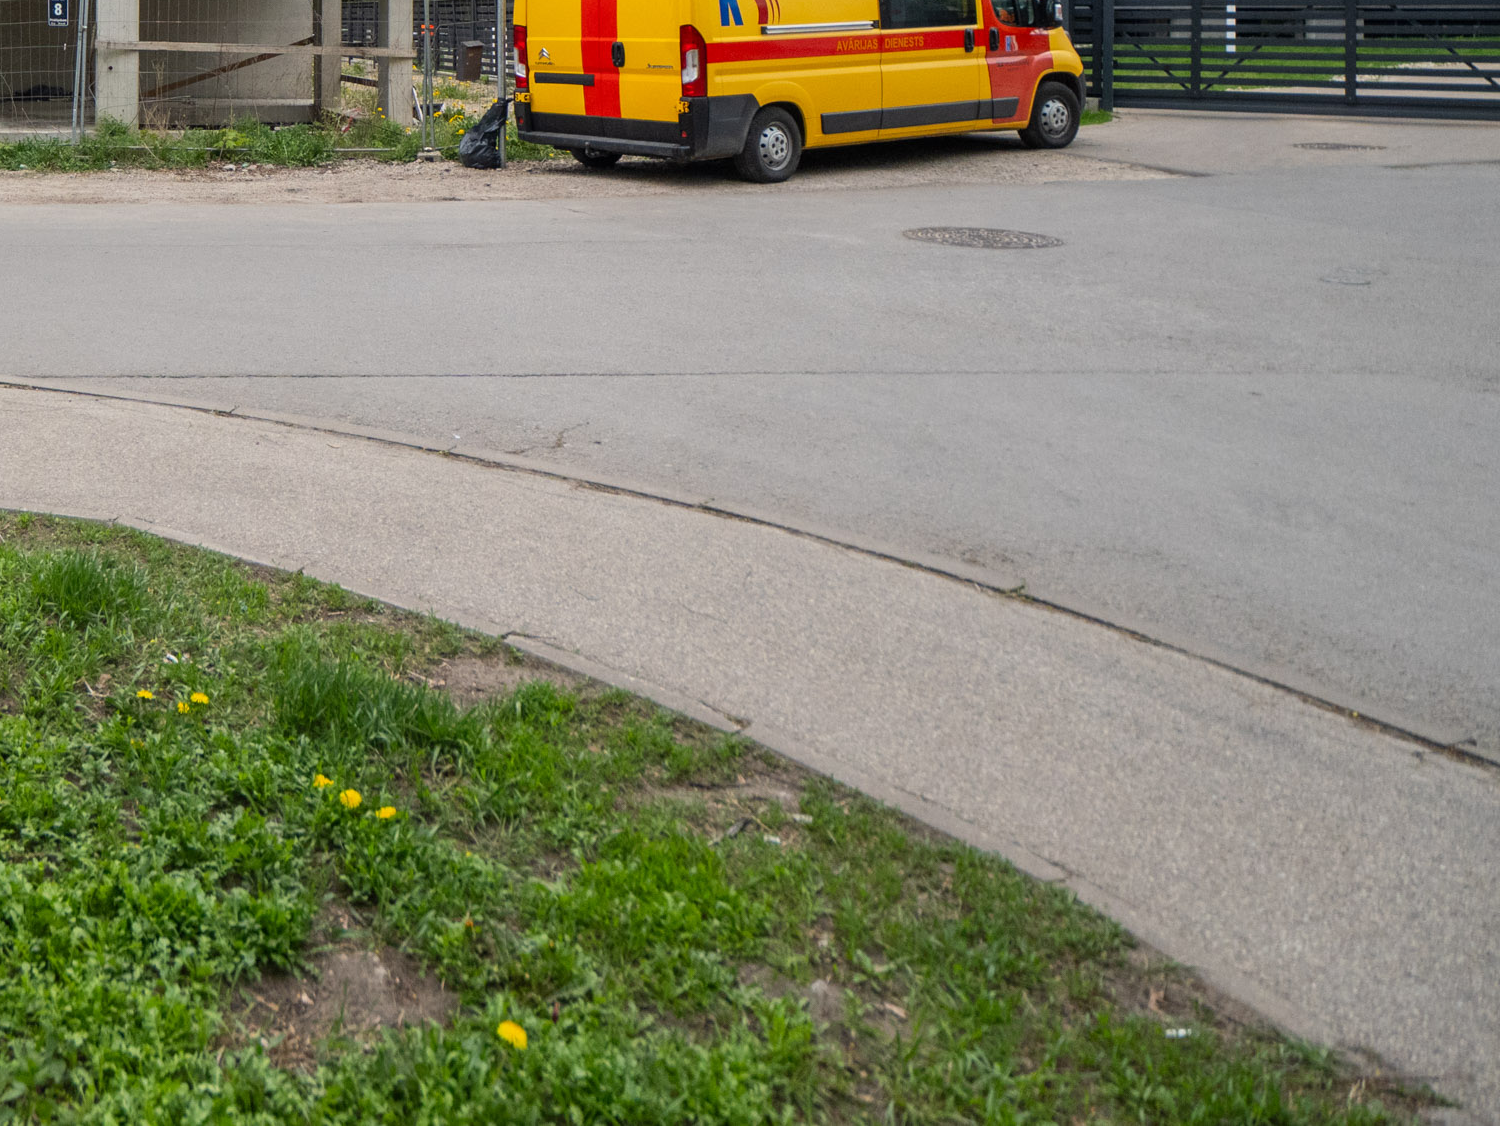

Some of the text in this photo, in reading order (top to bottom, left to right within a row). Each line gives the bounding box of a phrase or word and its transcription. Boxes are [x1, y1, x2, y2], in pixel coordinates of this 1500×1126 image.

[54, 3, 62, 15] 8
[836, 36, 924, 51] AVĀRIJAS DIENESTS
